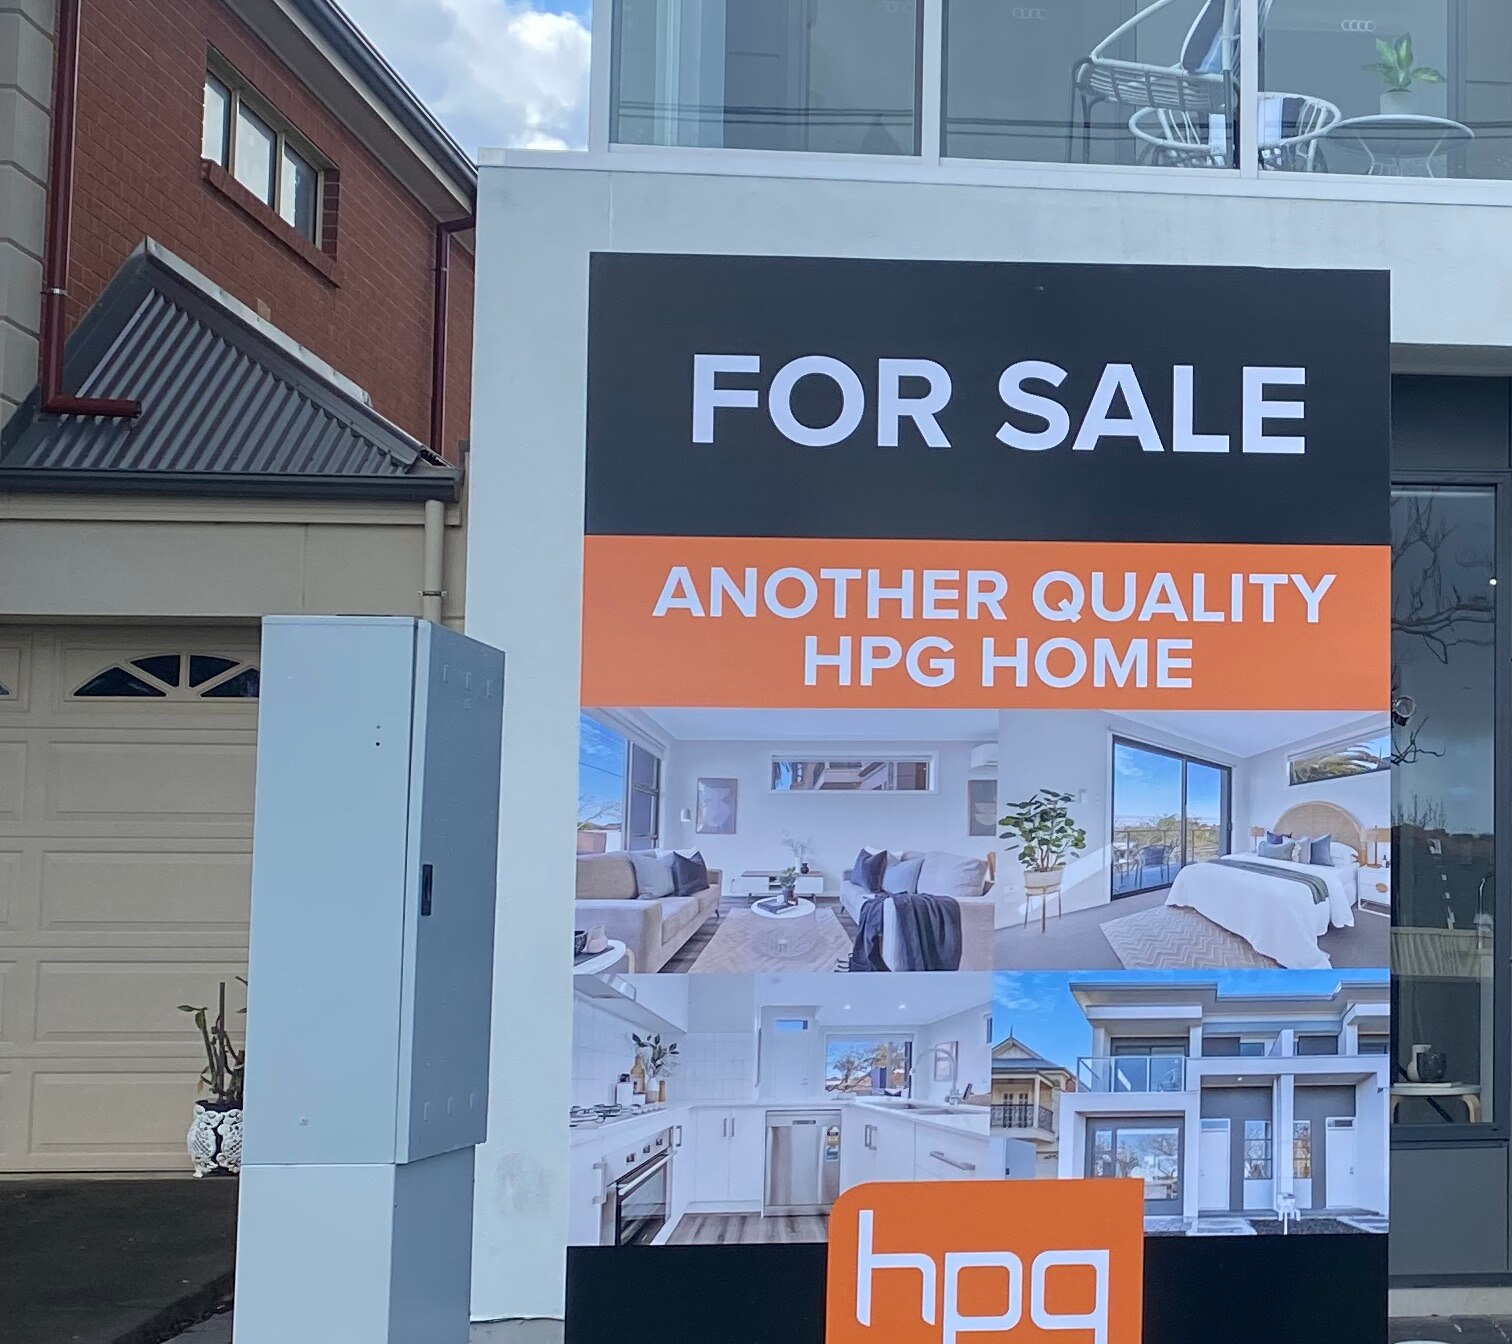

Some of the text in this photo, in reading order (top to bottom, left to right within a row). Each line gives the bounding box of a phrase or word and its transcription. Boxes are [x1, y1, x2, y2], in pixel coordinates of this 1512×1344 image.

[693, 354, 1306, 454] FOR SALE
[651, 566, 1337, 624] ANOTHER QUALITY
[804, 635, 1193, 689] HPG HOME
